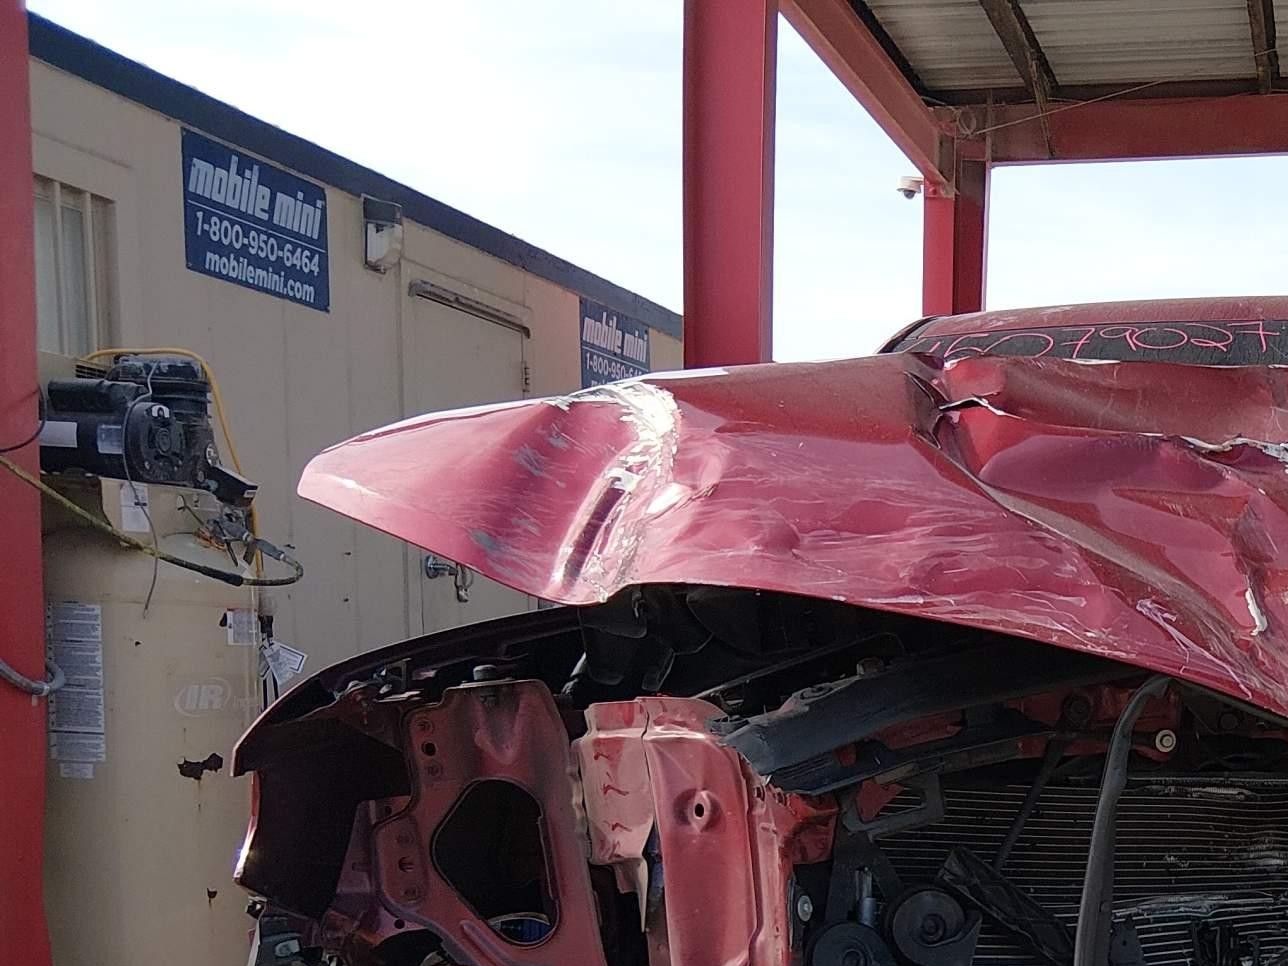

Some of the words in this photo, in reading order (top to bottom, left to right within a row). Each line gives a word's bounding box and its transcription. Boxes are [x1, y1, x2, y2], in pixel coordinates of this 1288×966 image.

[188, 155, 271, 221] mobile
[273, 191, 323, 240] mini
[196, 211, 320, 277] 1-800-950-6464
[205, 251, 315, 303] mobilemini.com
[583, 311, 623, 354] mobile
[623, 330, 648, 363] mini
[586, 352, 643, 380] 1-800-950-6
